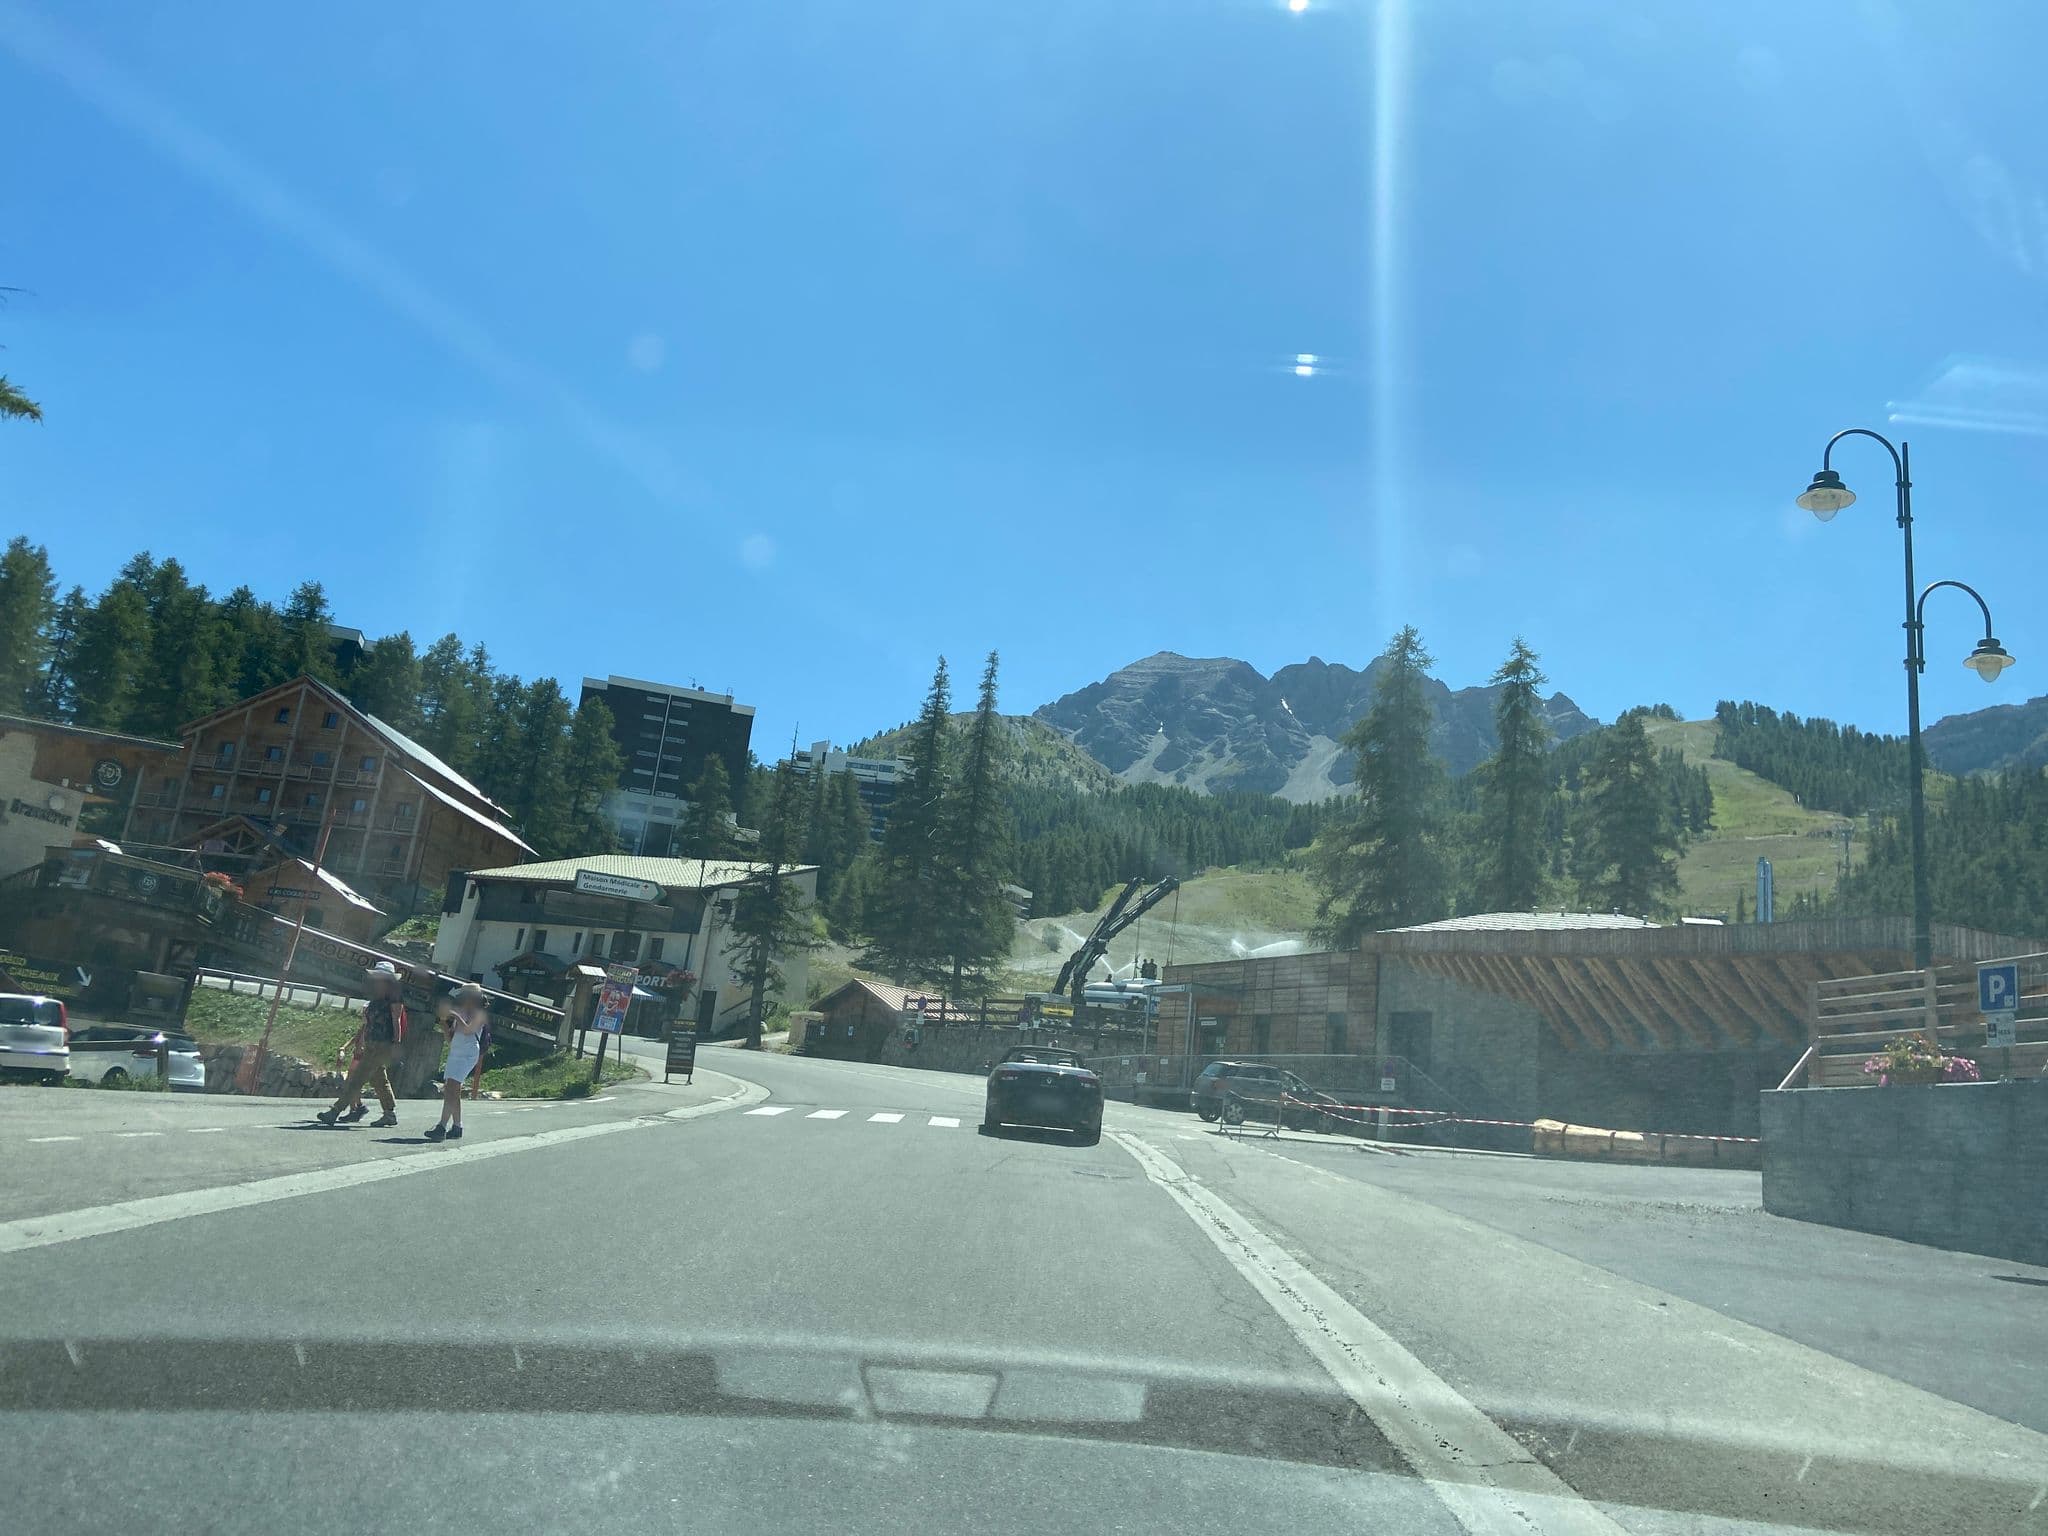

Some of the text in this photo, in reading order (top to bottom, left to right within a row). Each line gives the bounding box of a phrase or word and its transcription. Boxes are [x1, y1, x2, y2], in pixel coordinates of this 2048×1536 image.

[583, 873, 641, 889] Maison Médicale
[583, 882, 628, 895] Gendarmerie
[1989, 974, 2006, 1003] P
